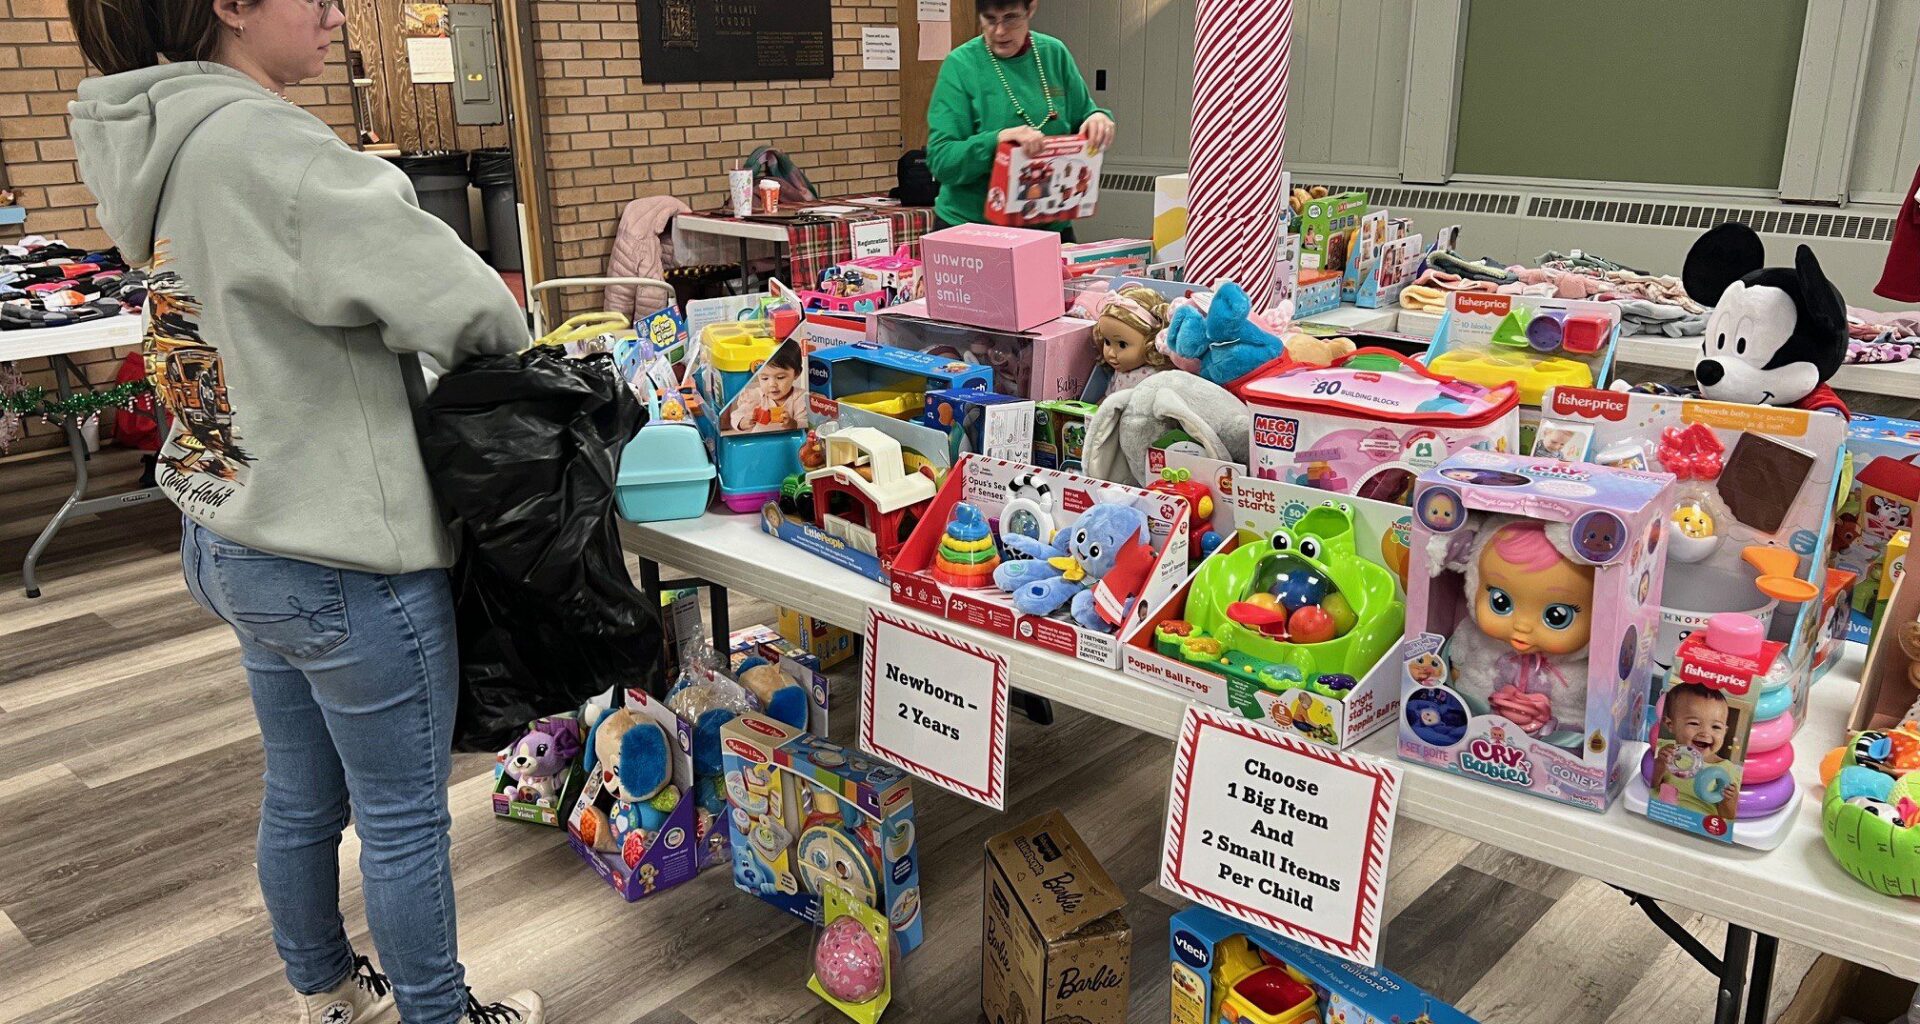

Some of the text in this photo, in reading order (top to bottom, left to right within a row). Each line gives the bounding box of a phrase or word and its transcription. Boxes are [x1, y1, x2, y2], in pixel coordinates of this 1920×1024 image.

[858, 237, 889, 248] Registration
[866, 247, 881, 255] Table
[933, 252, 984, 273] unwrap
[934, 270, 964, 285] your
[937, 288, 971, 304] smile
[1458, 296, 1508, 310] fisher-price
[1056, 375, 1078, 393] Baby
[1314, 380, 1400, 407] 80 BUILDING BLOCKS
[1557, 392, 1626, 412] fisher-price
[1255, 416, 1295, 433] MEGA
[1694, 405, 1728, 416] Rewards
[1730, 409, 1750, 418] baby
[1767, 415, 1794, 423] putting
[1254, 432, 1293, 448] BLOKS
[968, 476, 1006, 491] Opus's Sea
[978, 488, 1004, 500] Senses
[188, 481, 235, 508] Habit
[1237, 486, 1275, 503] bright
[1238, 498, 1276, 514] starts
[803, 525, 844, 550] Little People
[952, 599, 968, 612] 25+
[988, 610, 993, 620] 1
[1084, 634, 1108, 645] TEETHERS
[1080, 652, 1105, 663] DENTITION
[1128, 656, 1164, 677] Poppin'
[1165, 666, 1184, 683] Ball
[1684, 664, 1747, 688] fisher-price
[886, 663, 964, 709] Newborn
[1350, 689, 1373, 711] bright
[898, 703, 960, 741] 2 Years
[1348, 703, 1373, 722] starts
[1348, 701, 1400, 735] Poppin' Ball Fr
[1472, 739, 1525, 768] CRY
[1244, 758, 1319, 796] Choose
[1461, 753, 1533, 787] Babies
[1551, 765, 1599, 790] CONEY
[517, 811, 535, 819] Violet
[1228, 782, 1328, 830] 1 Big Item
[1711, 818, 1719, 826] 6
[1250, 819, 1294, 847] And
[1201, 830, 1341, 893] 2 Small Items
[1042, 871, 1083, 914] Barbie
[1218, 862, 1314, 912] Per Child
[987, 915, 1011, 972] Barbie
[1174, 935, 1207, 963] vtech
[1057, 965, 1122, 999] Barbie
[1341, 963, 1388, 993] Bulldozer
[1380, 976, 1400, 991] Pop
